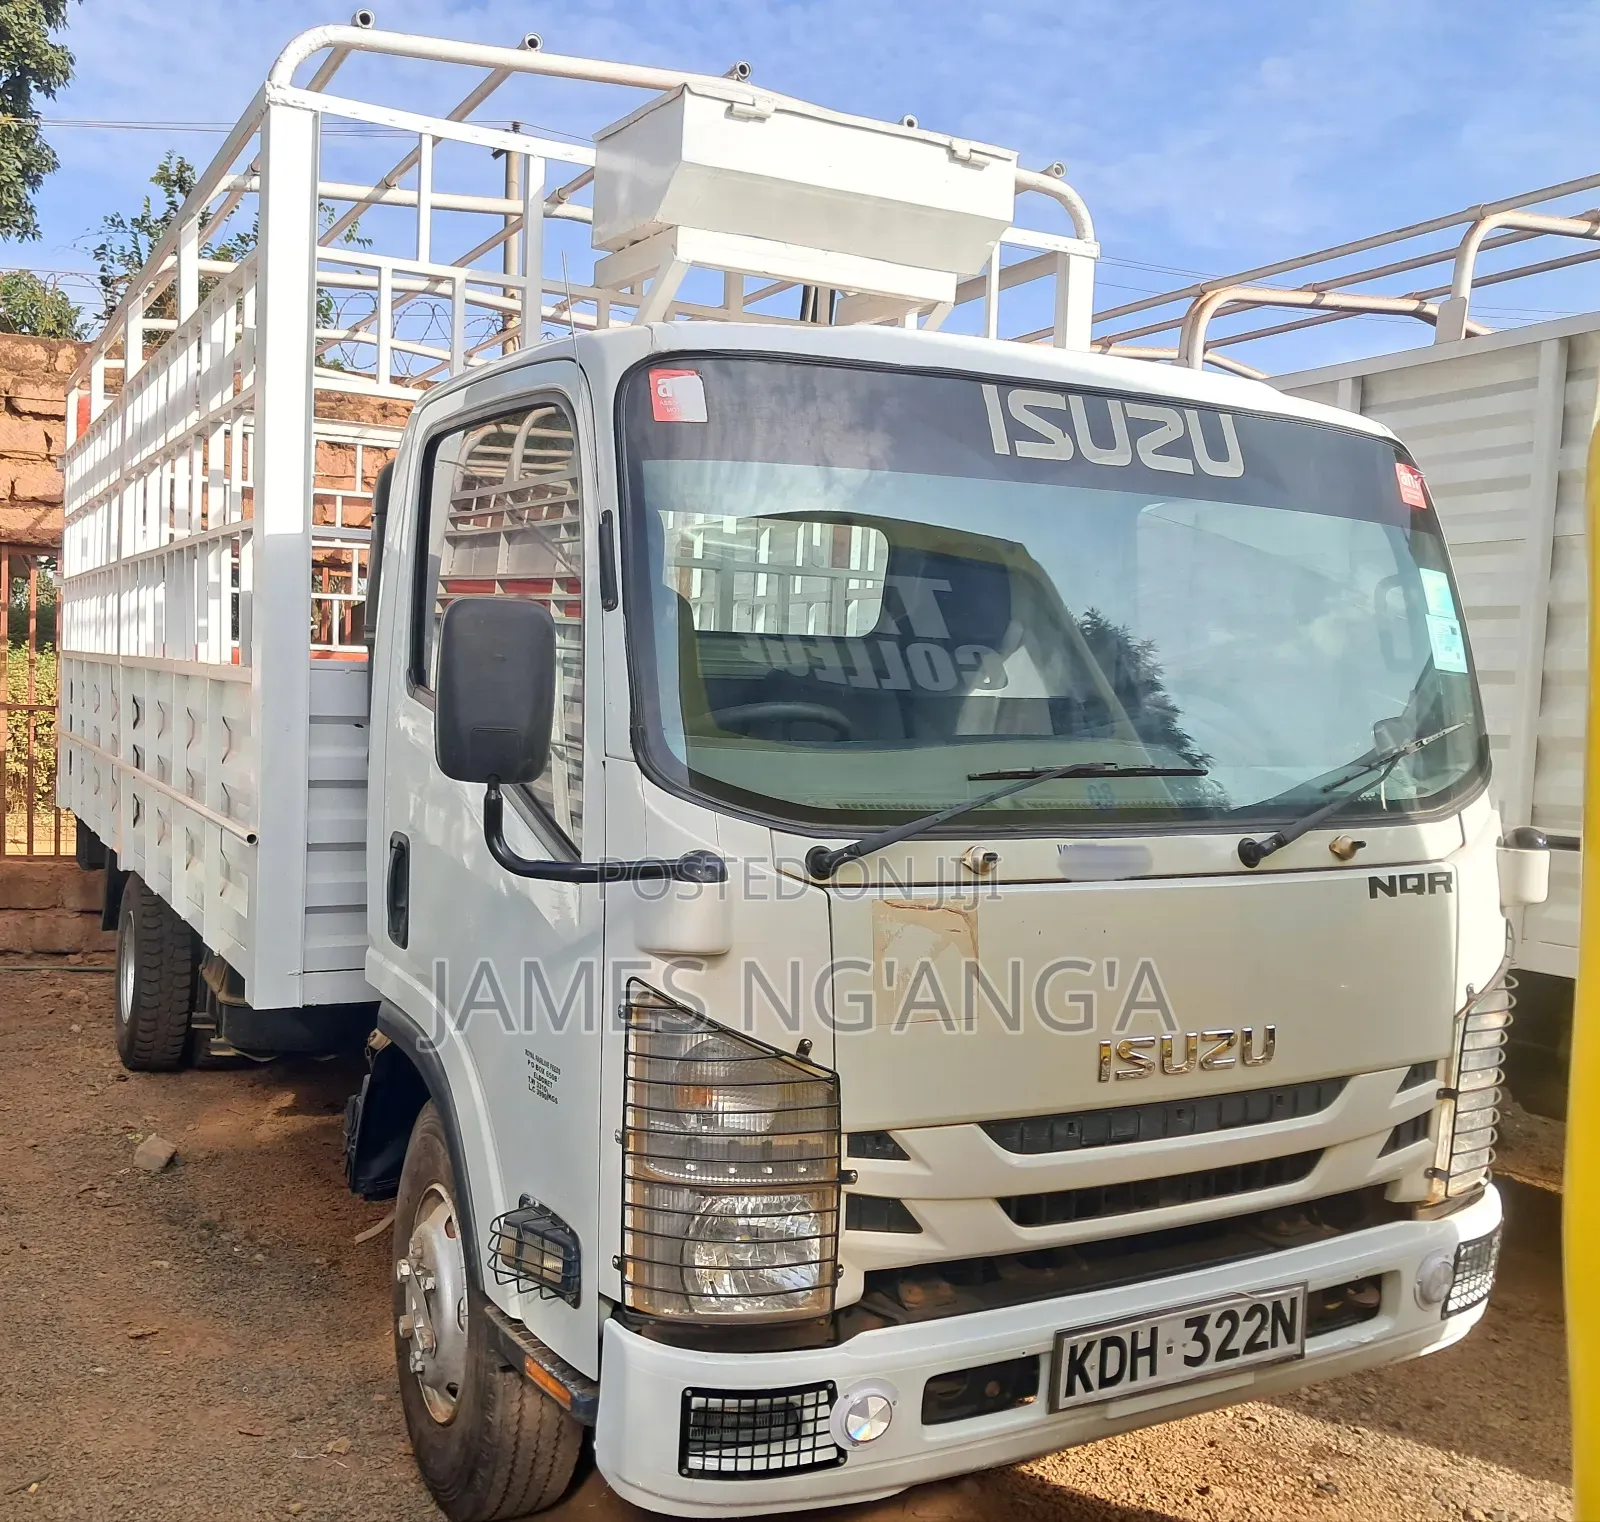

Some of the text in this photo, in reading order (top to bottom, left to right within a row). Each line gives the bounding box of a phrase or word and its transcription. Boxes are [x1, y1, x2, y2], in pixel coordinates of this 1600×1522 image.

[981, 384, 1244, 478] ISUZU
[1368, 872, 1452, 899] NQR
[1098, 1024, 1276, 1082] ISUZU
[1064, 1296, 1298, 1398] KDH 322N
